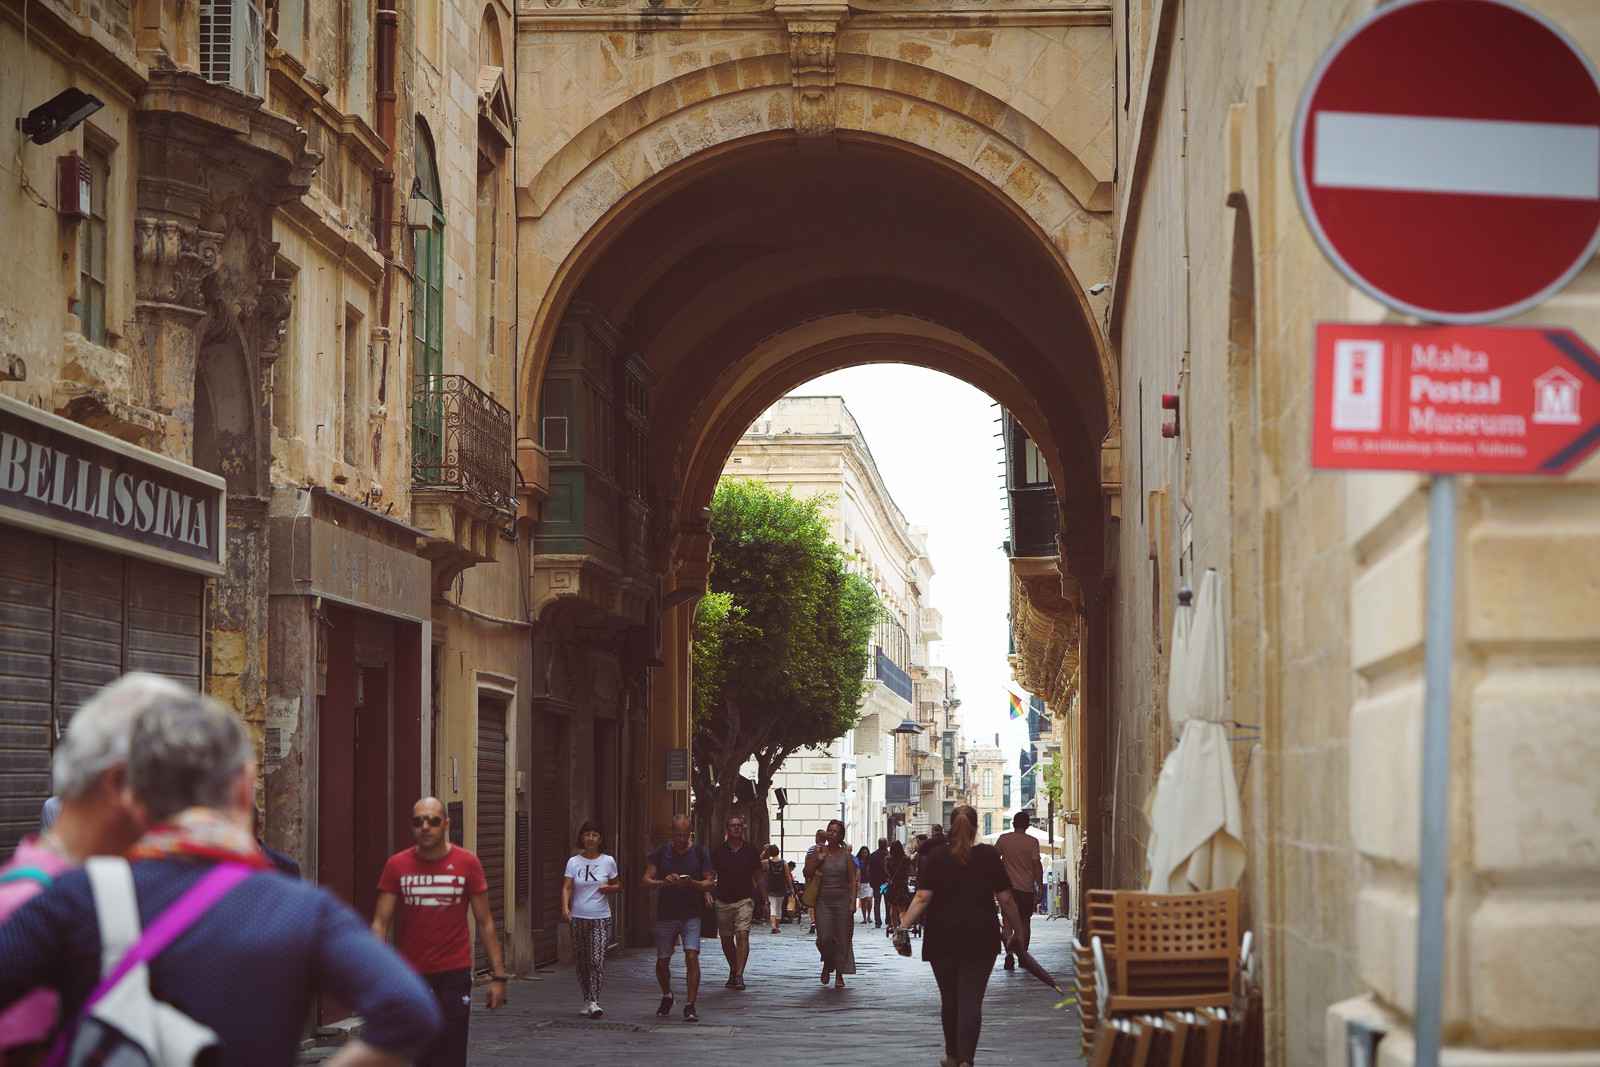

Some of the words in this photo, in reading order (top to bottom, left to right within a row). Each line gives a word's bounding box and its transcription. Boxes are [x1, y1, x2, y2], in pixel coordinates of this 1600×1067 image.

[1411, 343, 1489, 372] Malta
[1410, 375, 1501, 404] Postal
[1409, 406, 1526, 436] Museum
[0, 431, 209, 549] BELLISSIMA
